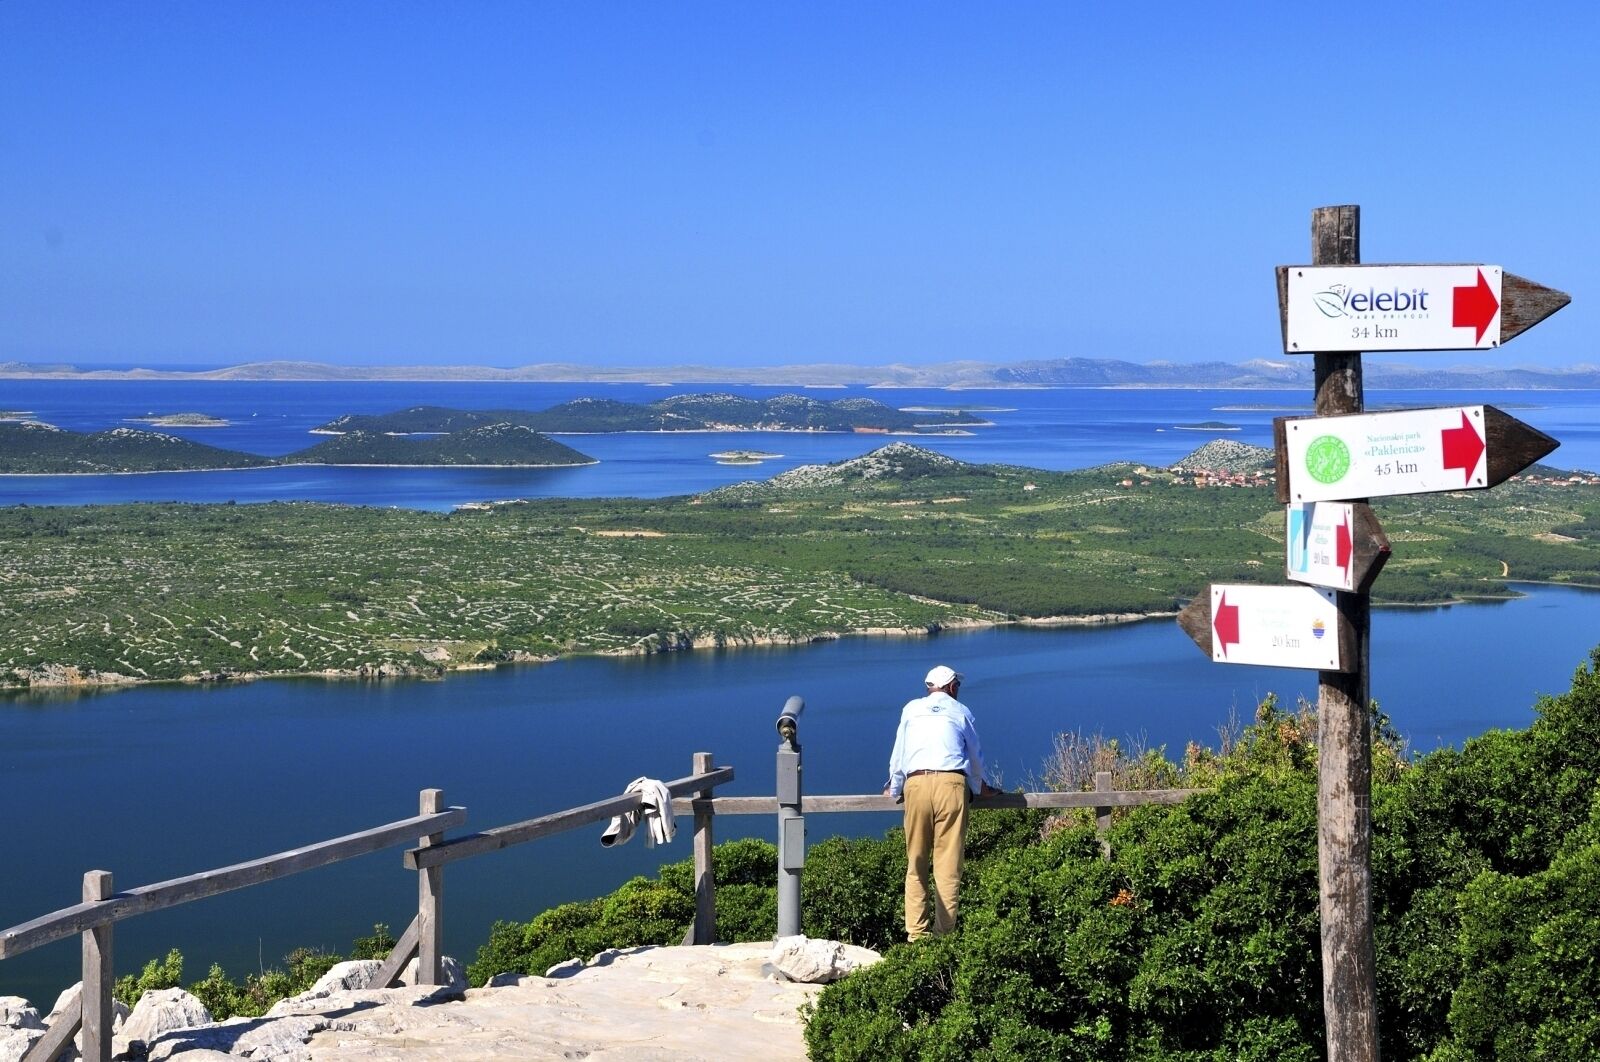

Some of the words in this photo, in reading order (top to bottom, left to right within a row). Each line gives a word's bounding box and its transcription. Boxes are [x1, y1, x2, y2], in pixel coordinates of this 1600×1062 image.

[1337, 286, 1429, 312] Velebit
[1351, 326, 1370, 339] 34
[1375, 324, 1399, 338] km
[1405, 431, 1421, 443] park
[1374, 463, 1391, 476] 45
[1395, 459, 1418, 474] km
[1271, 634, 1284, 648] 20
[1285, 633, 1301, 649] km
